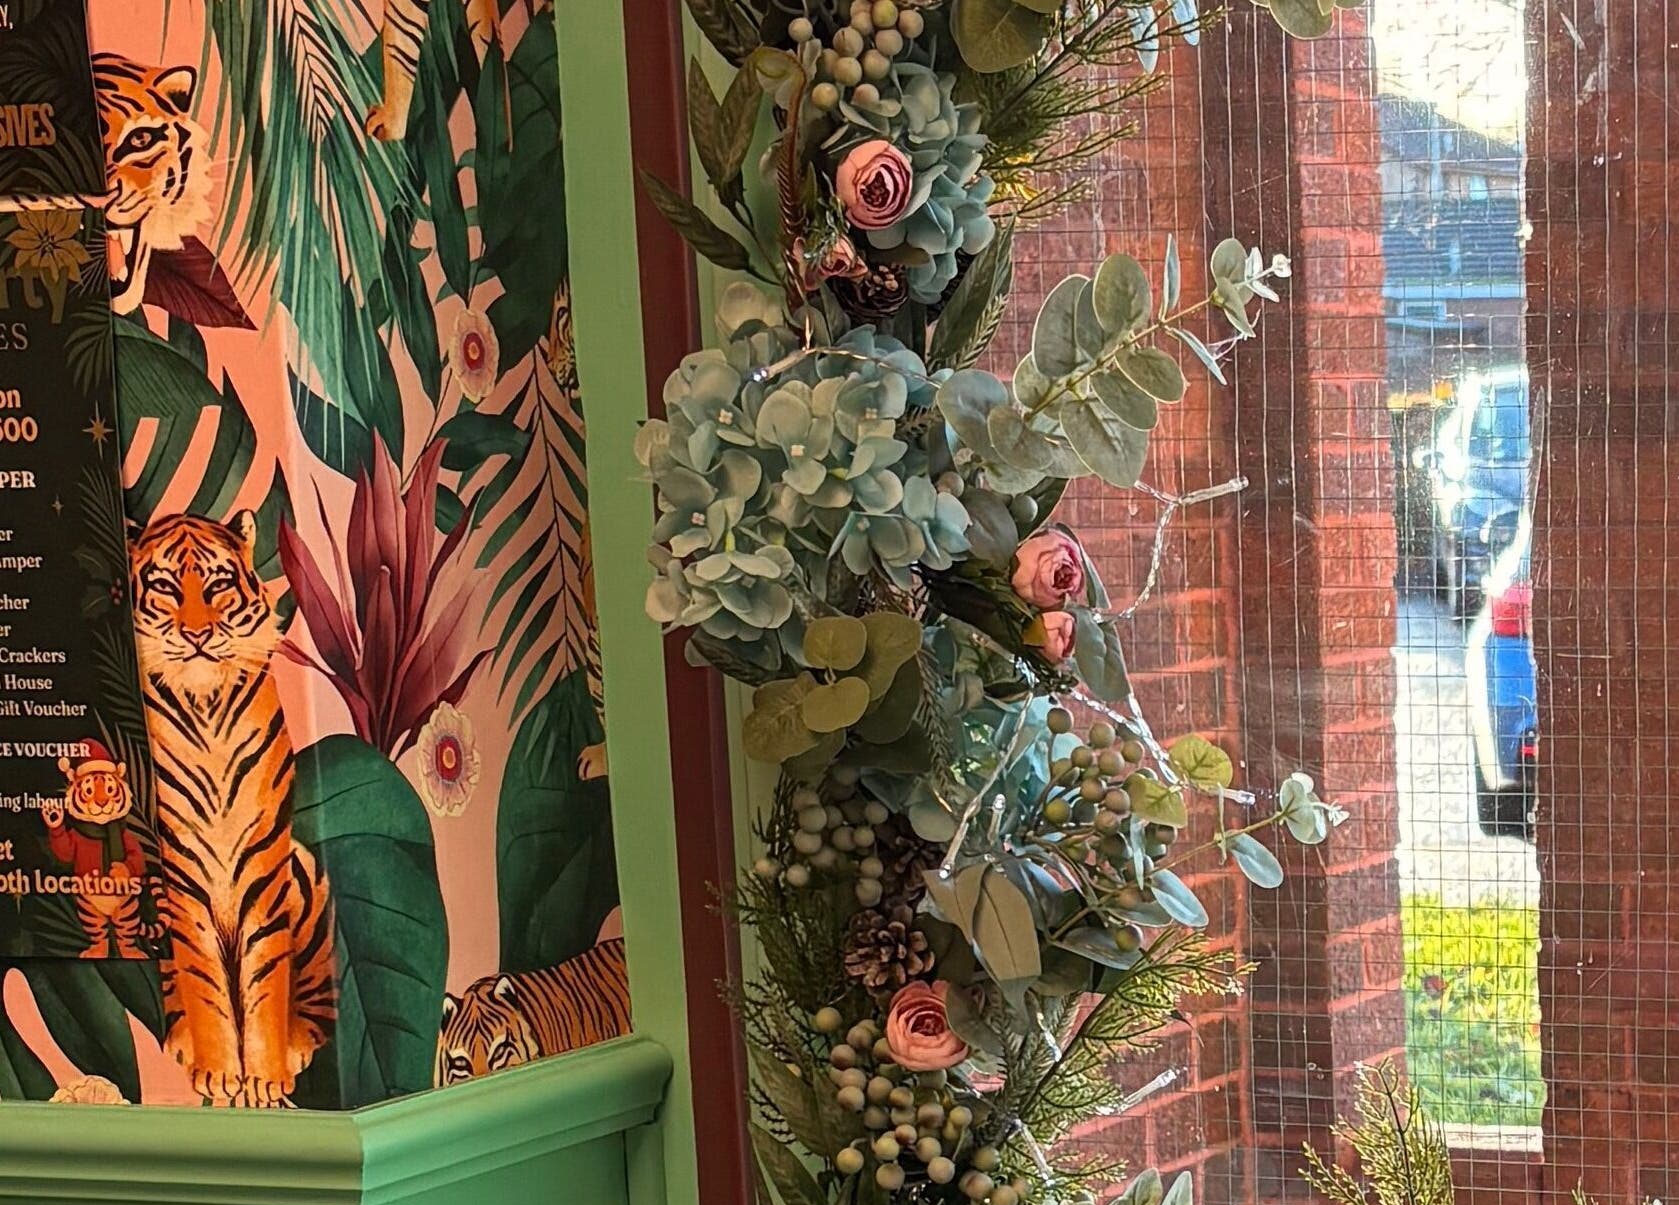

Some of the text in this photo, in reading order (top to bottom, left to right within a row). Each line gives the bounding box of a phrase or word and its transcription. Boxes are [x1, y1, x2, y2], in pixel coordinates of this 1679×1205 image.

[0, 415, 38, 442] 00
[0, 554, 43, 573] mper
[0, 646, 66, 663] Crackers
[4, 673, 53, 690] House
[23, 700, 87, 716] Voucher
[14, 742, 91, 758] VOUCHER
[35, 868, 142, 895] locations
